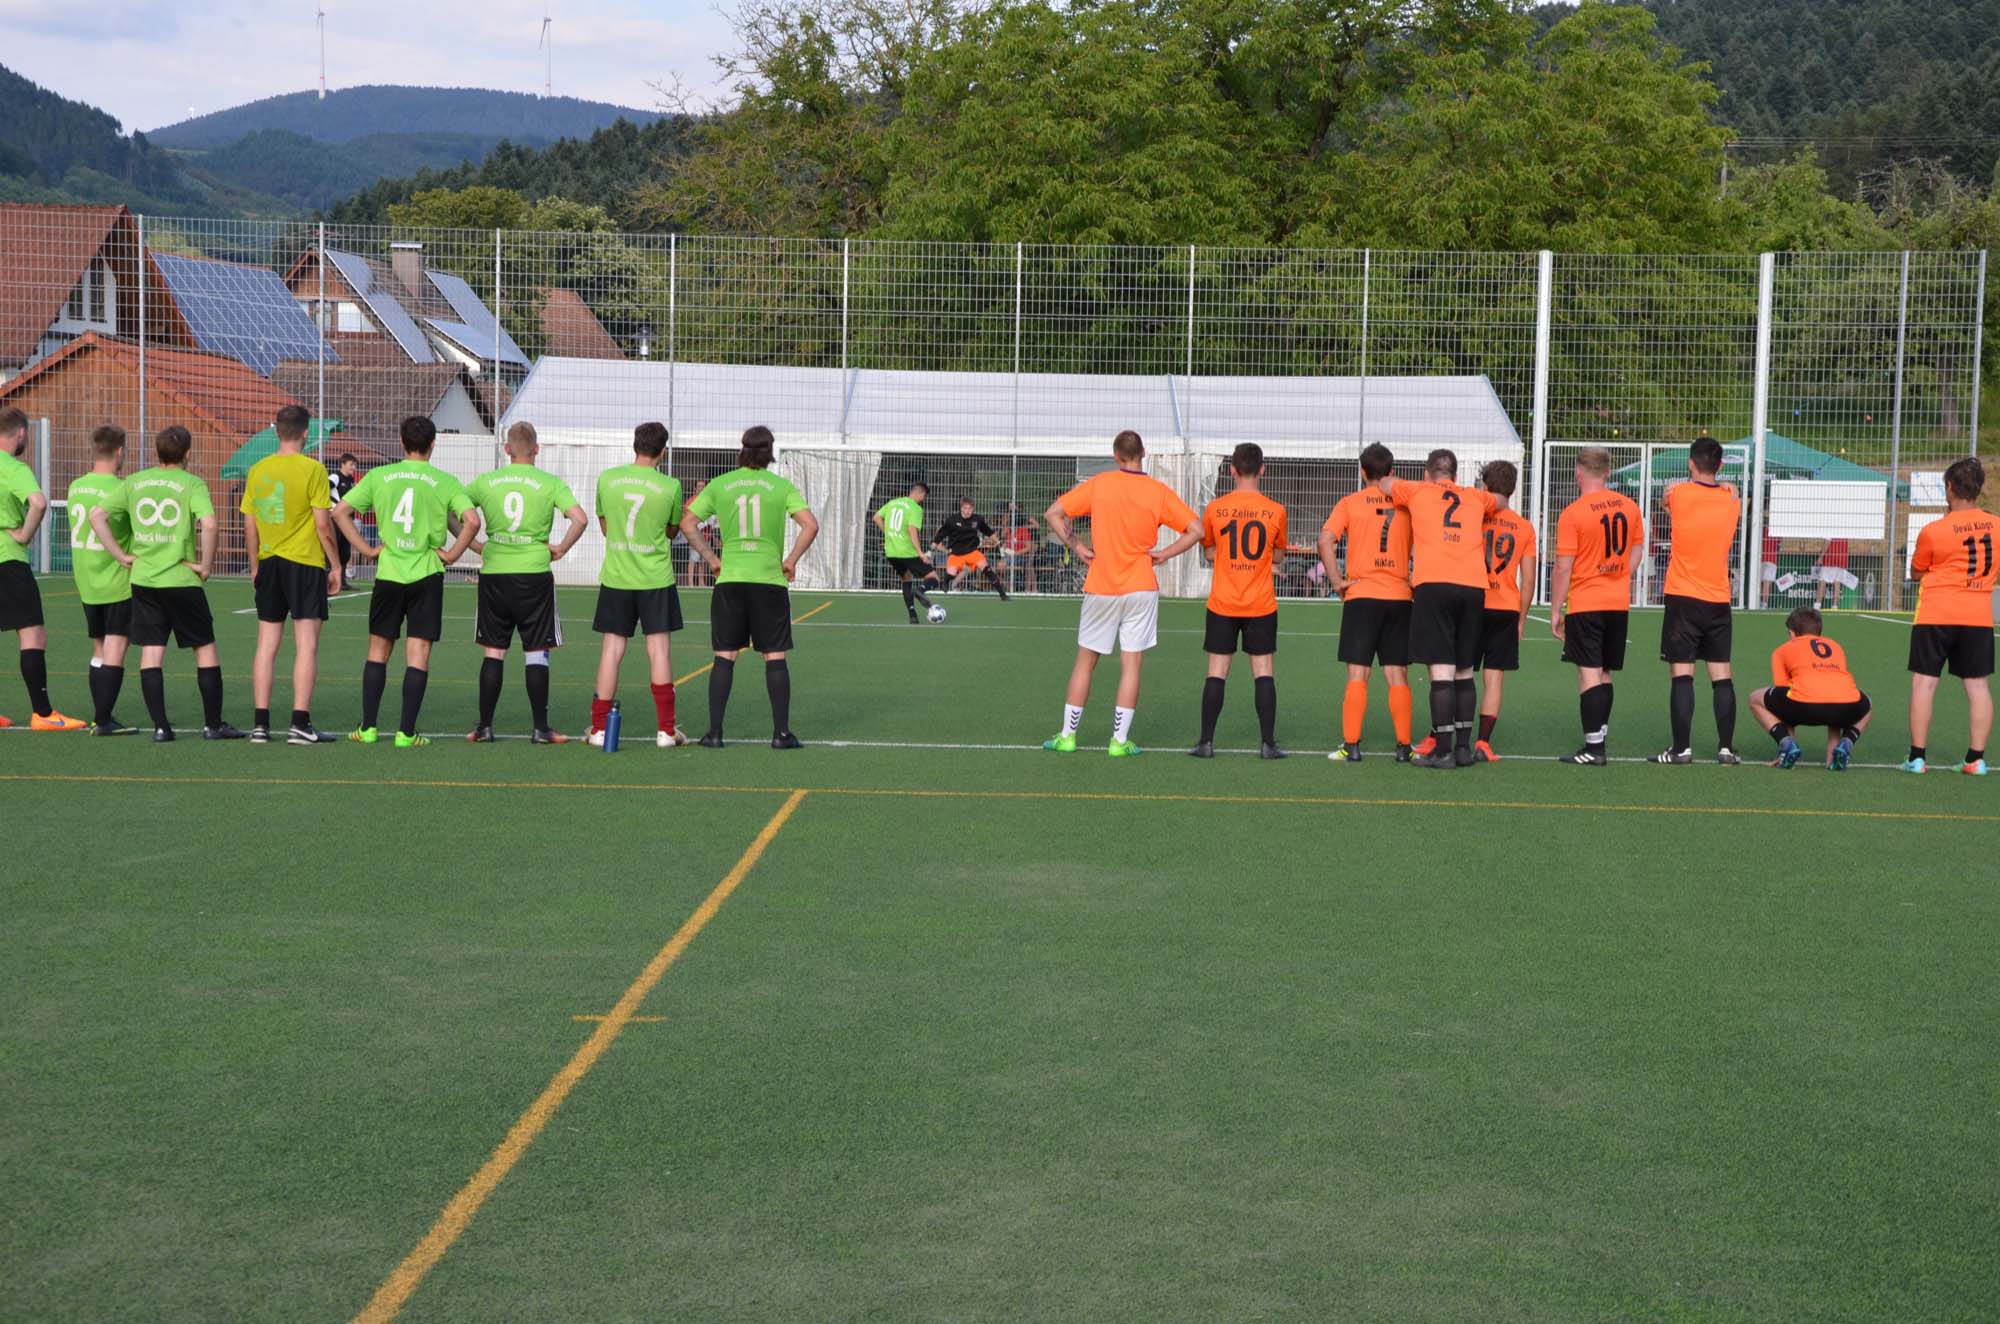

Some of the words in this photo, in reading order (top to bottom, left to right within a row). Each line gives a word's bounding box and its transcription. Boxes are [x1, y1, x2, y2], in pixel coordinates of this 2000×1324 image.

[392, 487, 414, 534] 4
[503, 491, 524, 532] 9
[623, 493, 645, 538] 7
[735, 493, 761, 539] 11
[889, 507, 903, 532] 10
[1216, 508, 1229, 518] SG
[1231, 508, 1258, 518] Zeller
[1260, 509, 1275, 520] FV
[1366, 496, 1384, 504] Devil
[1442, 490, 1462, 528] 2
[1220, 519, 1266, 560] 10
[1376, 508, 1397, 553] 7
[1483, 529, 1515, 574] 19
[1600, 511, 1628, 559] 10
[1962, 533, 1993, 577] 11
[1810, 638, 1833, 659] 6
